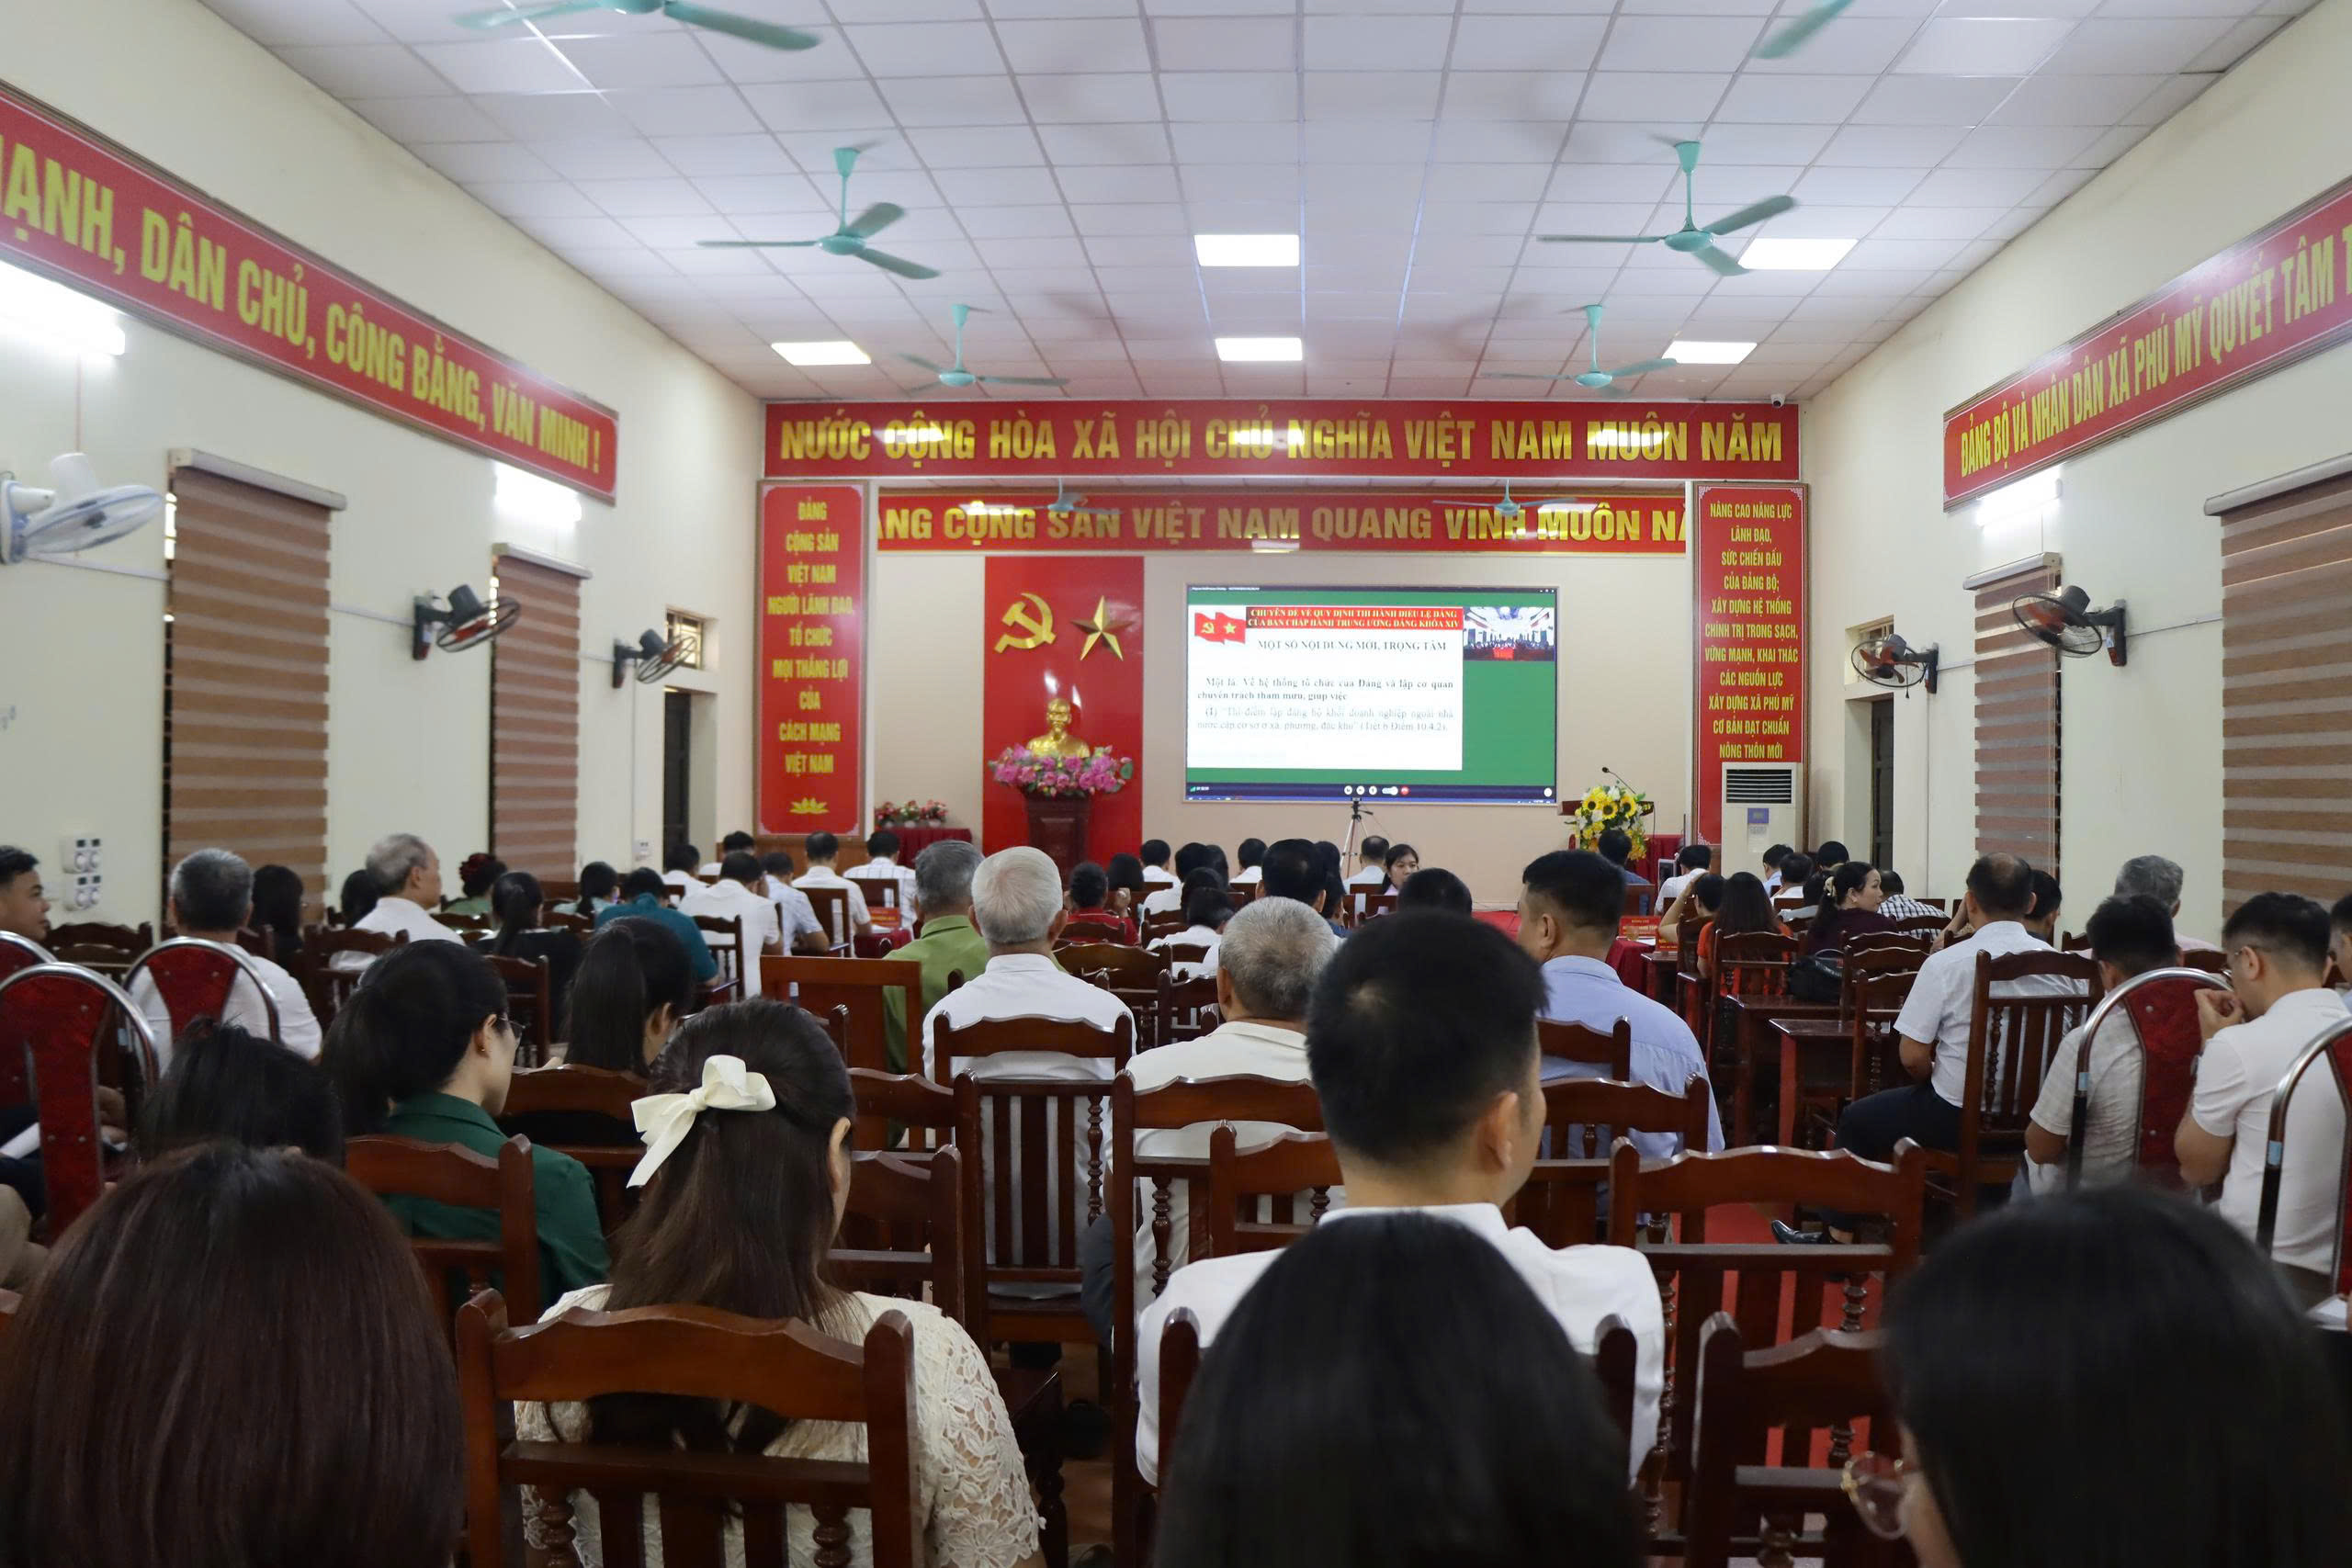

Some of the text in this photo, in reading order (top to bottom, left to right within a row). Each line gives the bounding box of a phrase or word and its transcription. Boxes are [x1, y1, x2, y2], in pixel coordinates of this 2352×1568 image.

[0, 134, 126, 276] ẠNH,
[141, 207, 226, 310] DÂN
[237, 258, 315, 359] CHỦ,
[325, 302, 405, 391] CÔNG
[412, 333, 486, 432] BẰNG,
[492, 381, 535, 446] VĂN
[539, 405, 589, 468] MINH
[1961, 413, 1991, 478] ĐẢNG
[1993, 400, 2009, 470] BỘ
[2012, 391, 2029, 453] VÀ
[2031, 373, 2069, 446] NHÂN
[2073, 355, 2104, 425] DÂN
[2108, 335, 2131, 409] XÃ
[2134, 312, 2169, 396] PHÚ
[2175, 294, 2203, 377] MỸ
[2210, 250, 2275, 365] QUYẾT
[2281, 235, 2334, 324] TÂM
[781, 405, 1781, 468] NƯỚC CỘNG HÒA XÃ HỘI CHỦ NGHĨA VIỆT NAM MUÔN NĂM
[944, 501, 1035, 546] CỘNG
[1046, 498, 1120, 538] SẢN
[1132, 501, 1205, 545] VIỆT
[1217, 508, 1300, 540] NAM
[1311, 507, 1431, 541] QUANG
[1443, 508, 1526, 540] VINH
[1537, 502, 1640, 541] MUÔN
[1652, 508, 1685, 541] N
[1710, 501, 1792, 522] NÂNG CAO NĂNG LỰC
[786, 527, 839, 556] CỘNG SẢN
[1731, 525, 1772, 545] LÃNH ĐẠO,
[1721, 547, 1781, 567] SỨC CHIẾN ĐẤU
[787, 562, 836, 587] VIỆT NAM
[1724, 571, 1740, 590] CỦA
[1742, 571, 1764, 590] ĐẢNG
[1712, 595, 1792, 617] XÂY DỰNG HỆ THỐNG
[1267, 618, 1284, 626] BAN
[1704, 621, 1798, 641] CHÍNH TRỊ TRONG SẠCH,
[1704, 645, 1798, 665] VỮNG MẠNH, KHAI THÁC
[1430, 682, 1453, 691] quan
[1720, 668, 1783, 690] CÁC NGUỒN LỰC
[799, 685, 821, 710] CỦA
[1257, 691, 1280, 699] tham
[1709, 693, 1724, 710] XÂY
[1726, 695, 1748, 713] DỰNG
[1750, 694, 1761, 710] XÃ
[1763, 694, 1780, 710] PHÚ
[779, 719, 841, 746] CÁCH MẠNG
[1713, 715, 1790, 738] CƠ BẢN ĐẠT CHUẨN
[1719, 741, 1783, 759] NÔNG THÔN MỚI
[785, 750, 833, 777] VIỆT NAM
